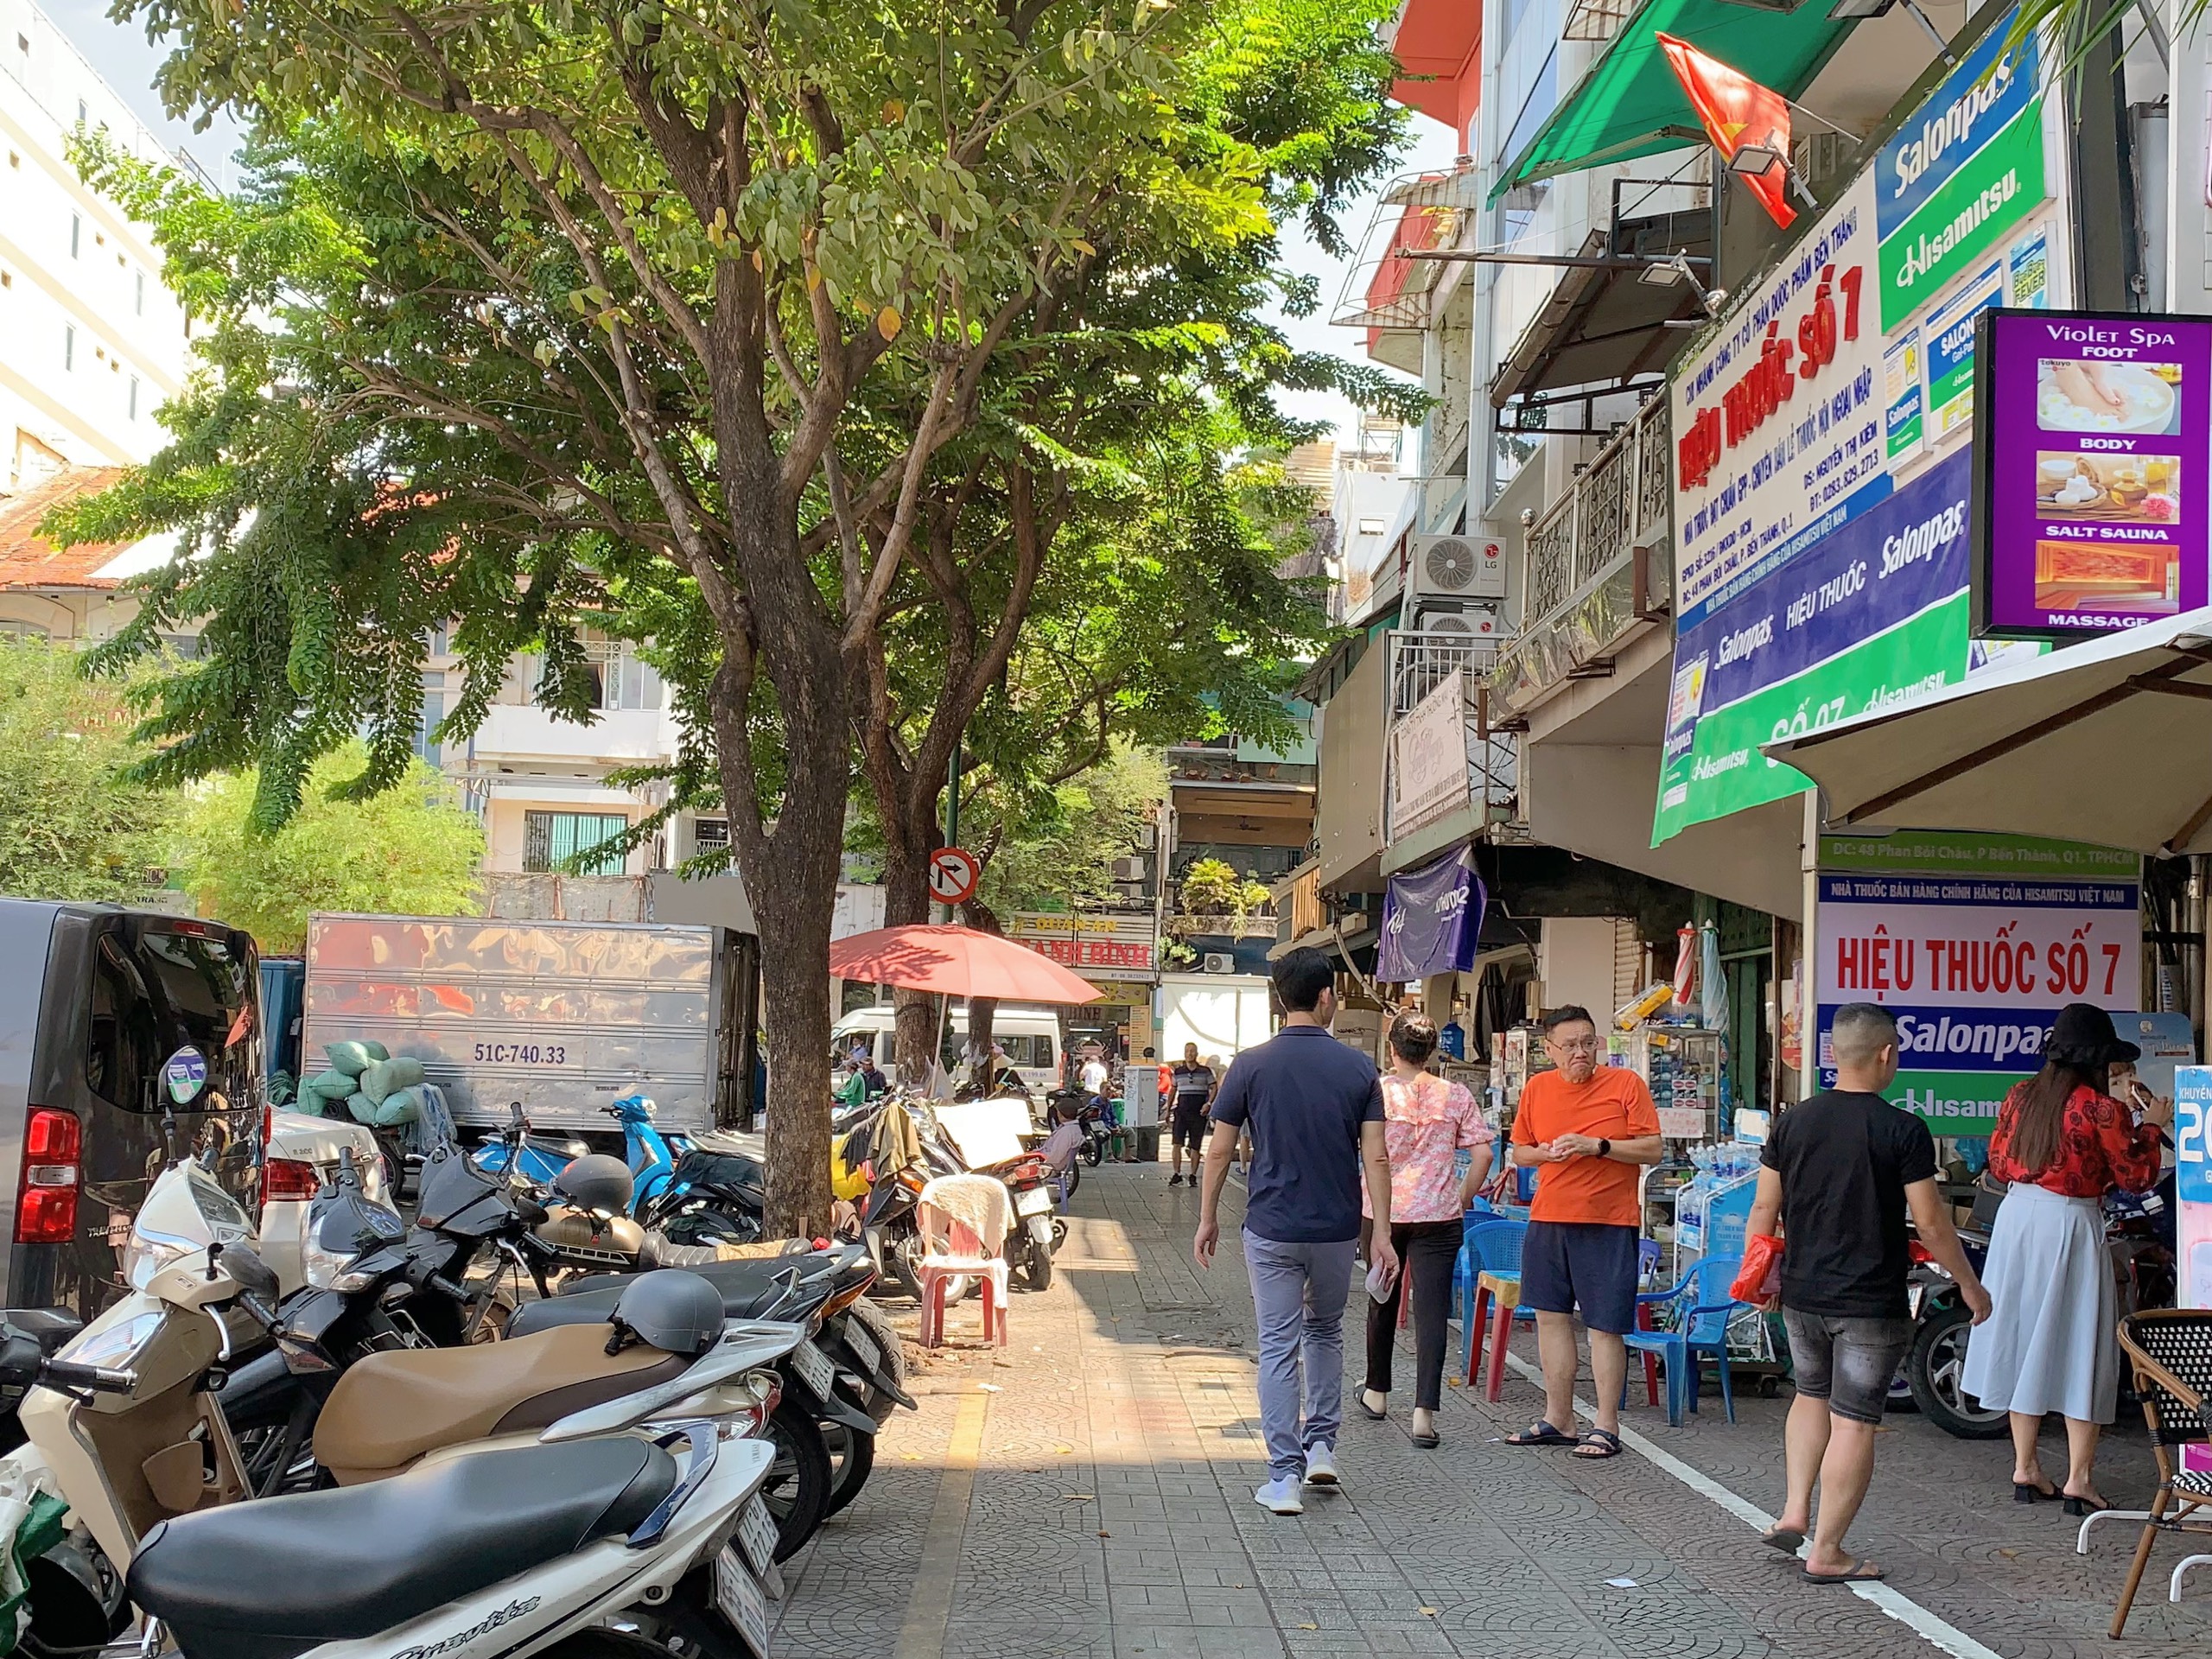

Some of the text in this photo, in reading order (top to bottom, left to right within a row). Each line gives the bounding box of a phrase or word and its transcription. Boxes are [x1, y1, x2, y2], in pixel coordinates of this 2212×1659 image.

[1894, 52, 2012, 200] Salonpas
[1896, 168, 2016, 287] Hisamitsu
[1732, 331, 1740, 358] TY
[1771, 279, 1789, 321] DƯỢC
[1815, 229, 1828, 272] BẾN
[1723, 320, 1795, 448] THUỐC
[1799, 264, 1836, 379] SỐ
[2082, 346, 2138, 359] FOOT
[2080, 438, 2136, 450] BODY
[1816, 443, 1842, 480] NGUYỄN
[2045, 526, 2169, 540] SALT SAUNA
[1485, 561, 1497, 569] LG
[1713, 614, 1774, 671] Salonpas
[1786, 591, 1816, 631] HIỆU
[1819, 560, 1866, 612] THUỐC
[1878, 499, 1966, 580] Salonpas
[2048, 614, 2150, 628] MASSAGE
[1692, 748, 1749, 781] Hisamitsu
[1859, 844, 1874, 856] 48
[1878, 844, 1911, 857] Phan
[1914, 845, 1935, 861] Bội
[1989, 846, 2013, 861] Bến
[2088, 850, 2134, 864] TPHCM
[1831, 880, 1852, 897] NHÀ
[1854, 880, 1888, 898] THUỐC
[1890, 881, 1910, 898] BÁN
[1912, 882, 1939, 899] HÀNG
[1942, 883, 1971, 899] CHÍNH
[2003, 883, 2022, 900] CỦA
[2024, 887, 2075, 902] HISAMITSU
[2079, 887, 2101, 904] VIỆT
[2103, 889, 2125, 903] NAM
[1838, 920, 2121, 1001] HIỆU THUỐC SỐ 7
[474, 1043, 565, 1065] 51C-740.33
[1890, 1088, 2000, 1118] Hisam
[390, 1595, 542, 1659] Gravita
